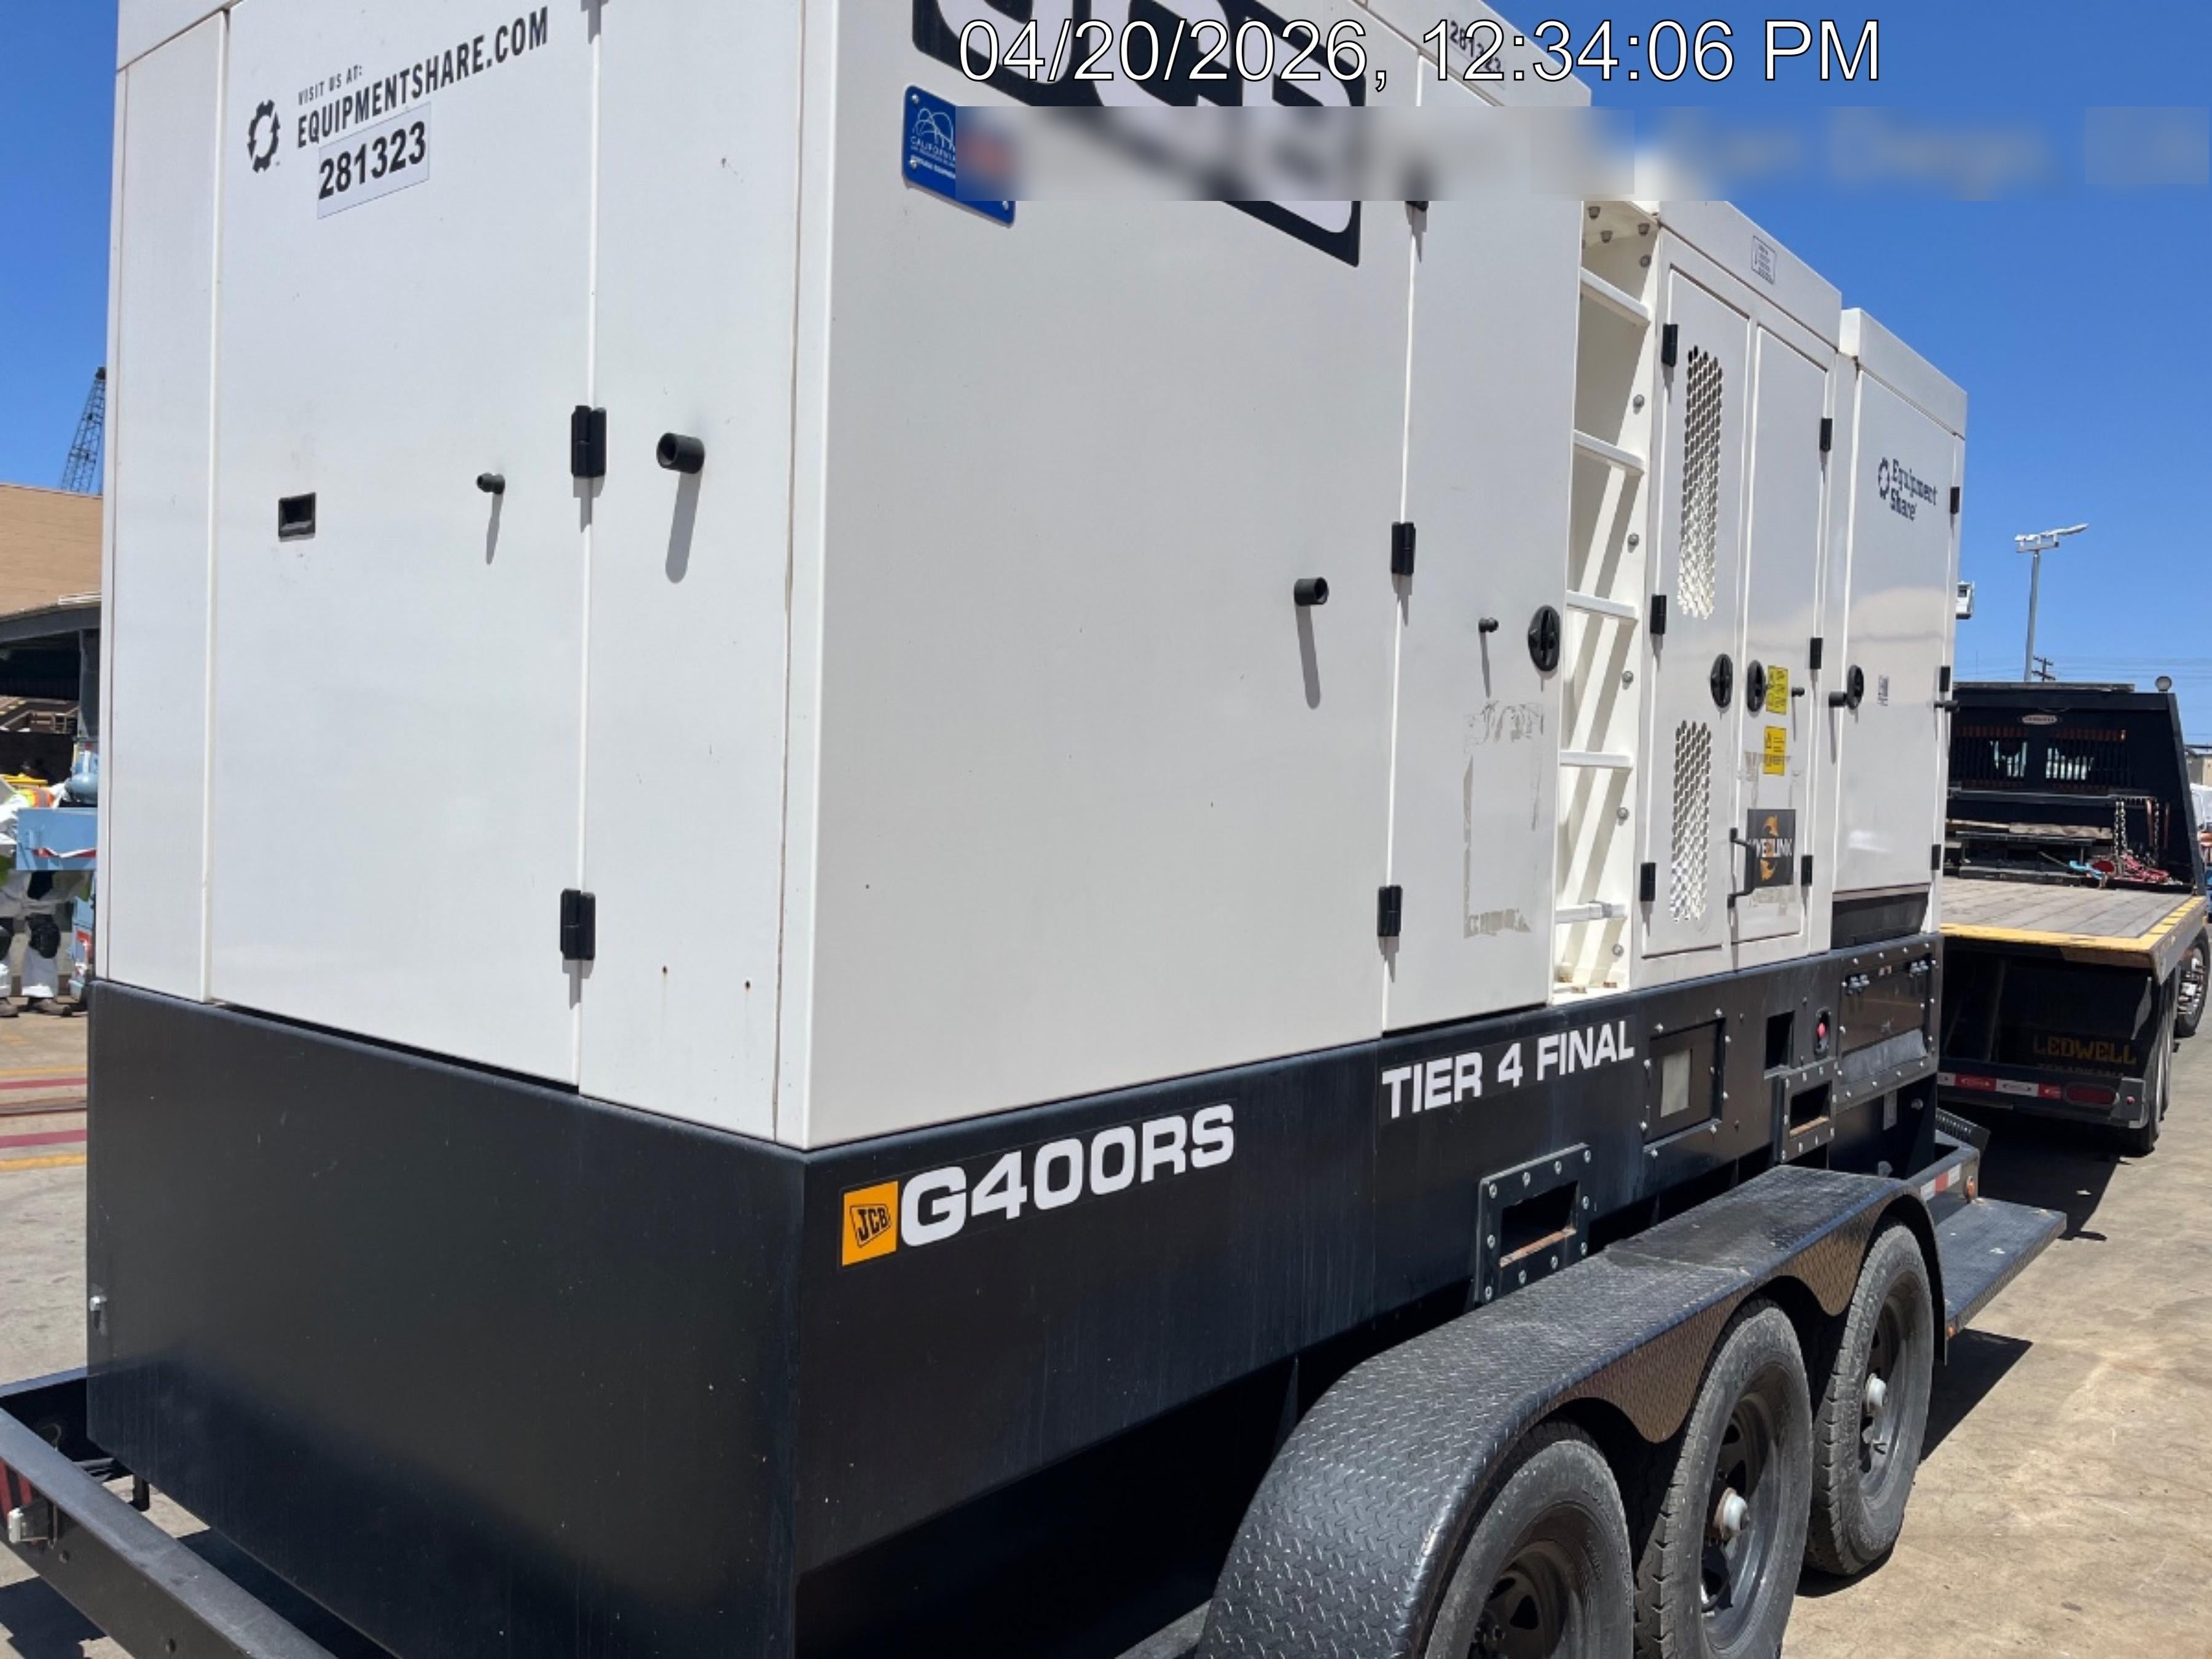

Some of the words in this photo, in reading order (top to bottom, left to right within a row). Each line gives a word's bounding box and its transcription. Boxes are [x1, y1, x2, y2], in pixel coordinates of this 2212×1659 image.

[297, 6, 549, 148] EQUIPMENTSHARE.COM
[298, 80, 324, 105] VISIT
[329, 73, 342, 92] US
[346, 64, 362, 84] AT:
[318, 121, 426, 200] 281323
[1891, 488, 1916, 522] Share
[1892, 458, 1938, 506] Equipment
[1382, 1052, 1483, 1119] TIER
[1497, 1043, 1523, 1087] 4
[1537, 1021, 1635, 1081] FINAL
[2033, 1034, 2137, 1064] LEDWELL
[857, 1207, 888, 1241] JCB
[901, 1104, 1234, 1247] G400RS
